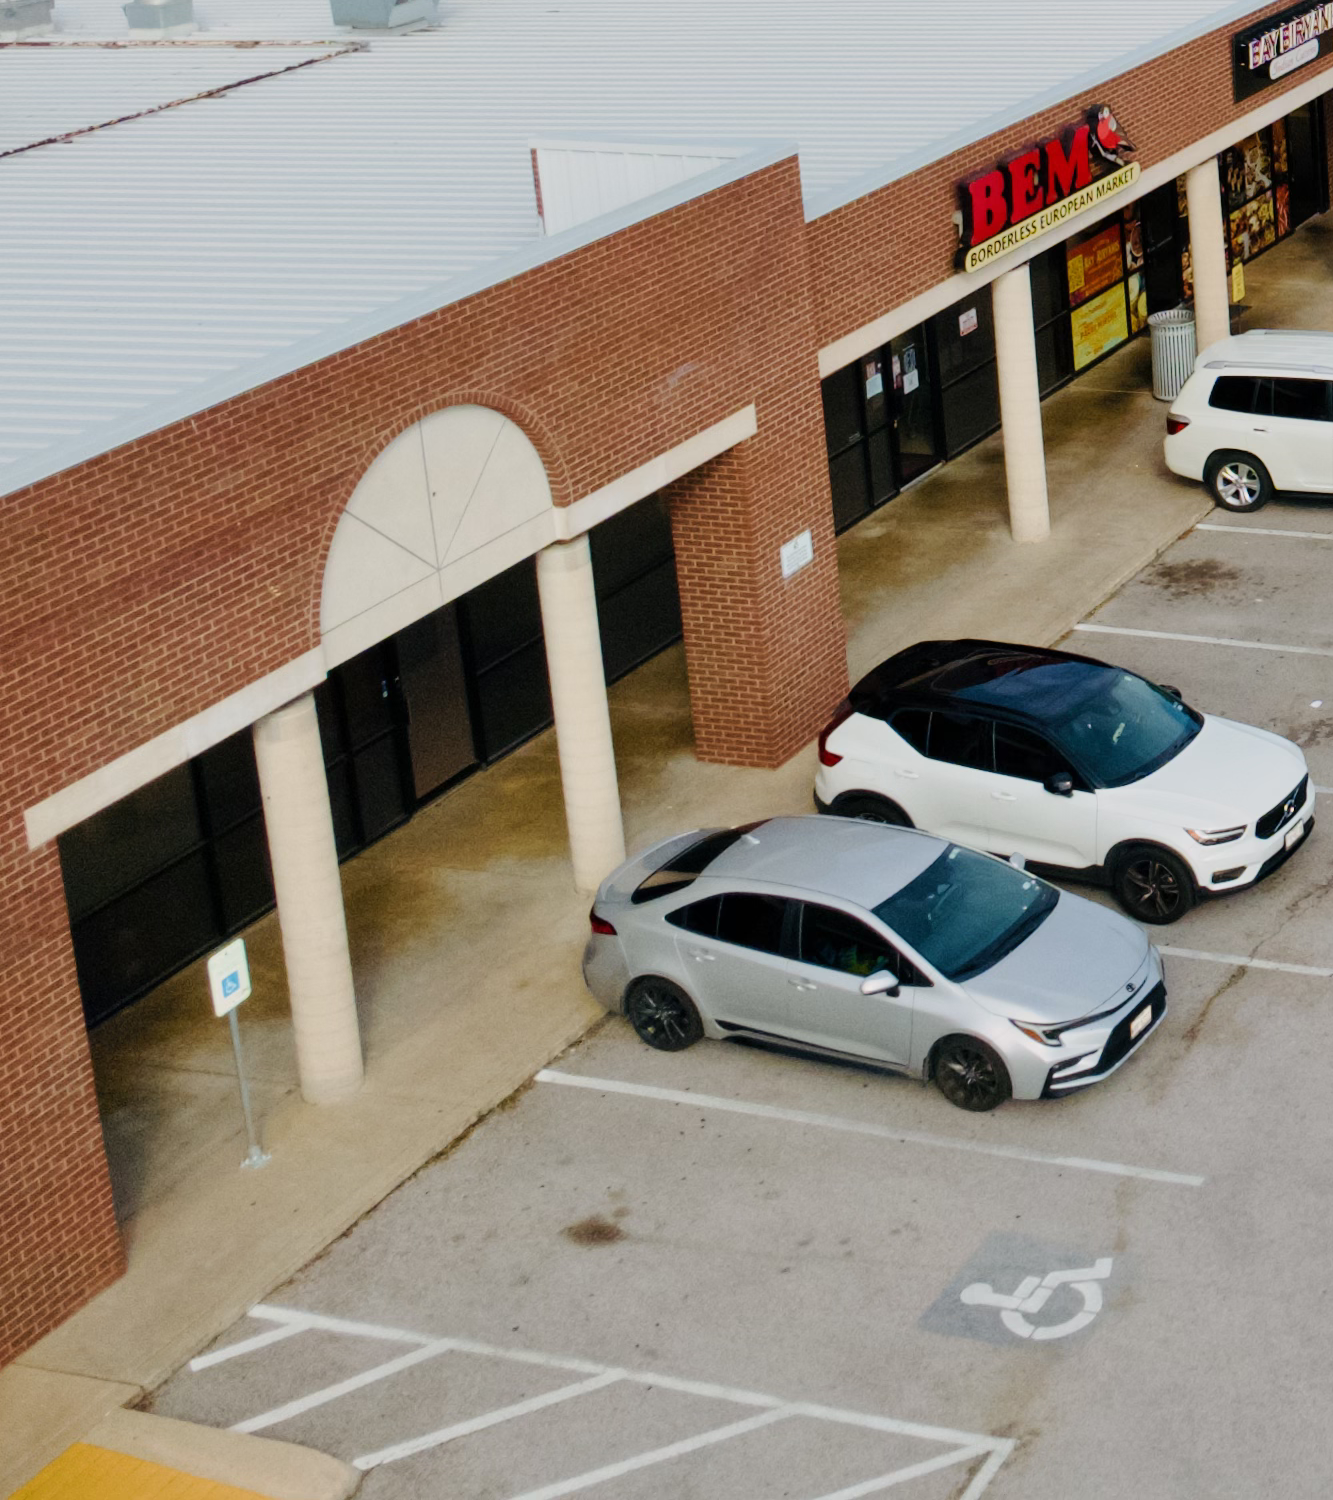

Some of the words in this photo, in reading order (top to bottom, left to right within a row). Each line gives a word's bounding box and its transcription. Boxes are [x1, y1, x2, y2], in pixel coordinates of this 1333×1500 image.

[1249, 28, 1279, 70] BAY
[969, 124, 1092, 247] BEM
[970, 218, 1037, 268] BORDERLESS
[1040, 191, 1094, 230] EUROPEAN
[1096, 166, 1135, 200] MARKET
